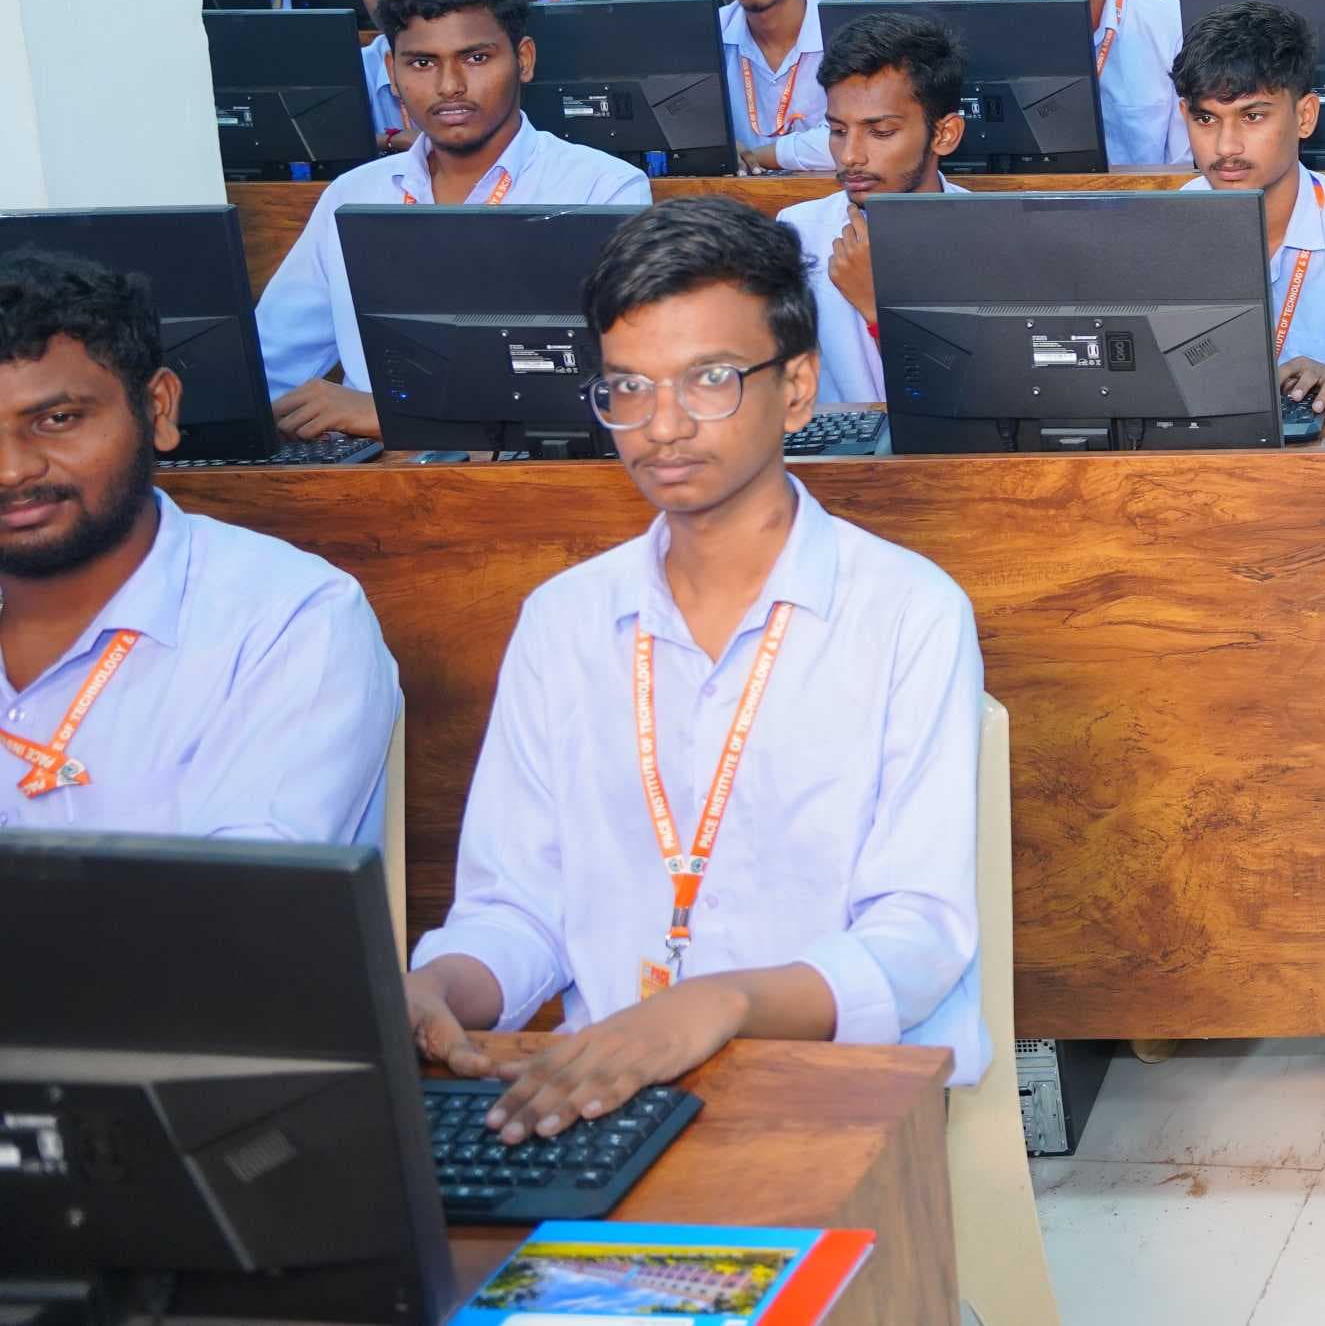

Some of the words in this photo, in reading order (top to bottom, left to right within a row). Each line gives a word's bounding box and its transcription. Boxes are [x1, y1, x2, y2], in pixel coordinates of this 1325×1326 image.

[1284, 267, 1305, 319] TECHNOLOGY
[1281, 318, 1290, 330] OF
[766, 641, 778, 653] &
[59, 723, 74, 741] OF
[69, 644, 128, 724] TECHNOLOGY
[636, 653, 652, 733] TECHNOLOGY
[735, 654, 774, 733] TECHNOLOGY
[640, 736, 653, 753] OF
[729, 733, 744, 752] OF
[641, 754, 669, 819] INSTITUTE
[707, 753, 738, 818] INSTITUTE
[655, 817, 676, 849] PACE
[698, 816, 720, 850] PACE
